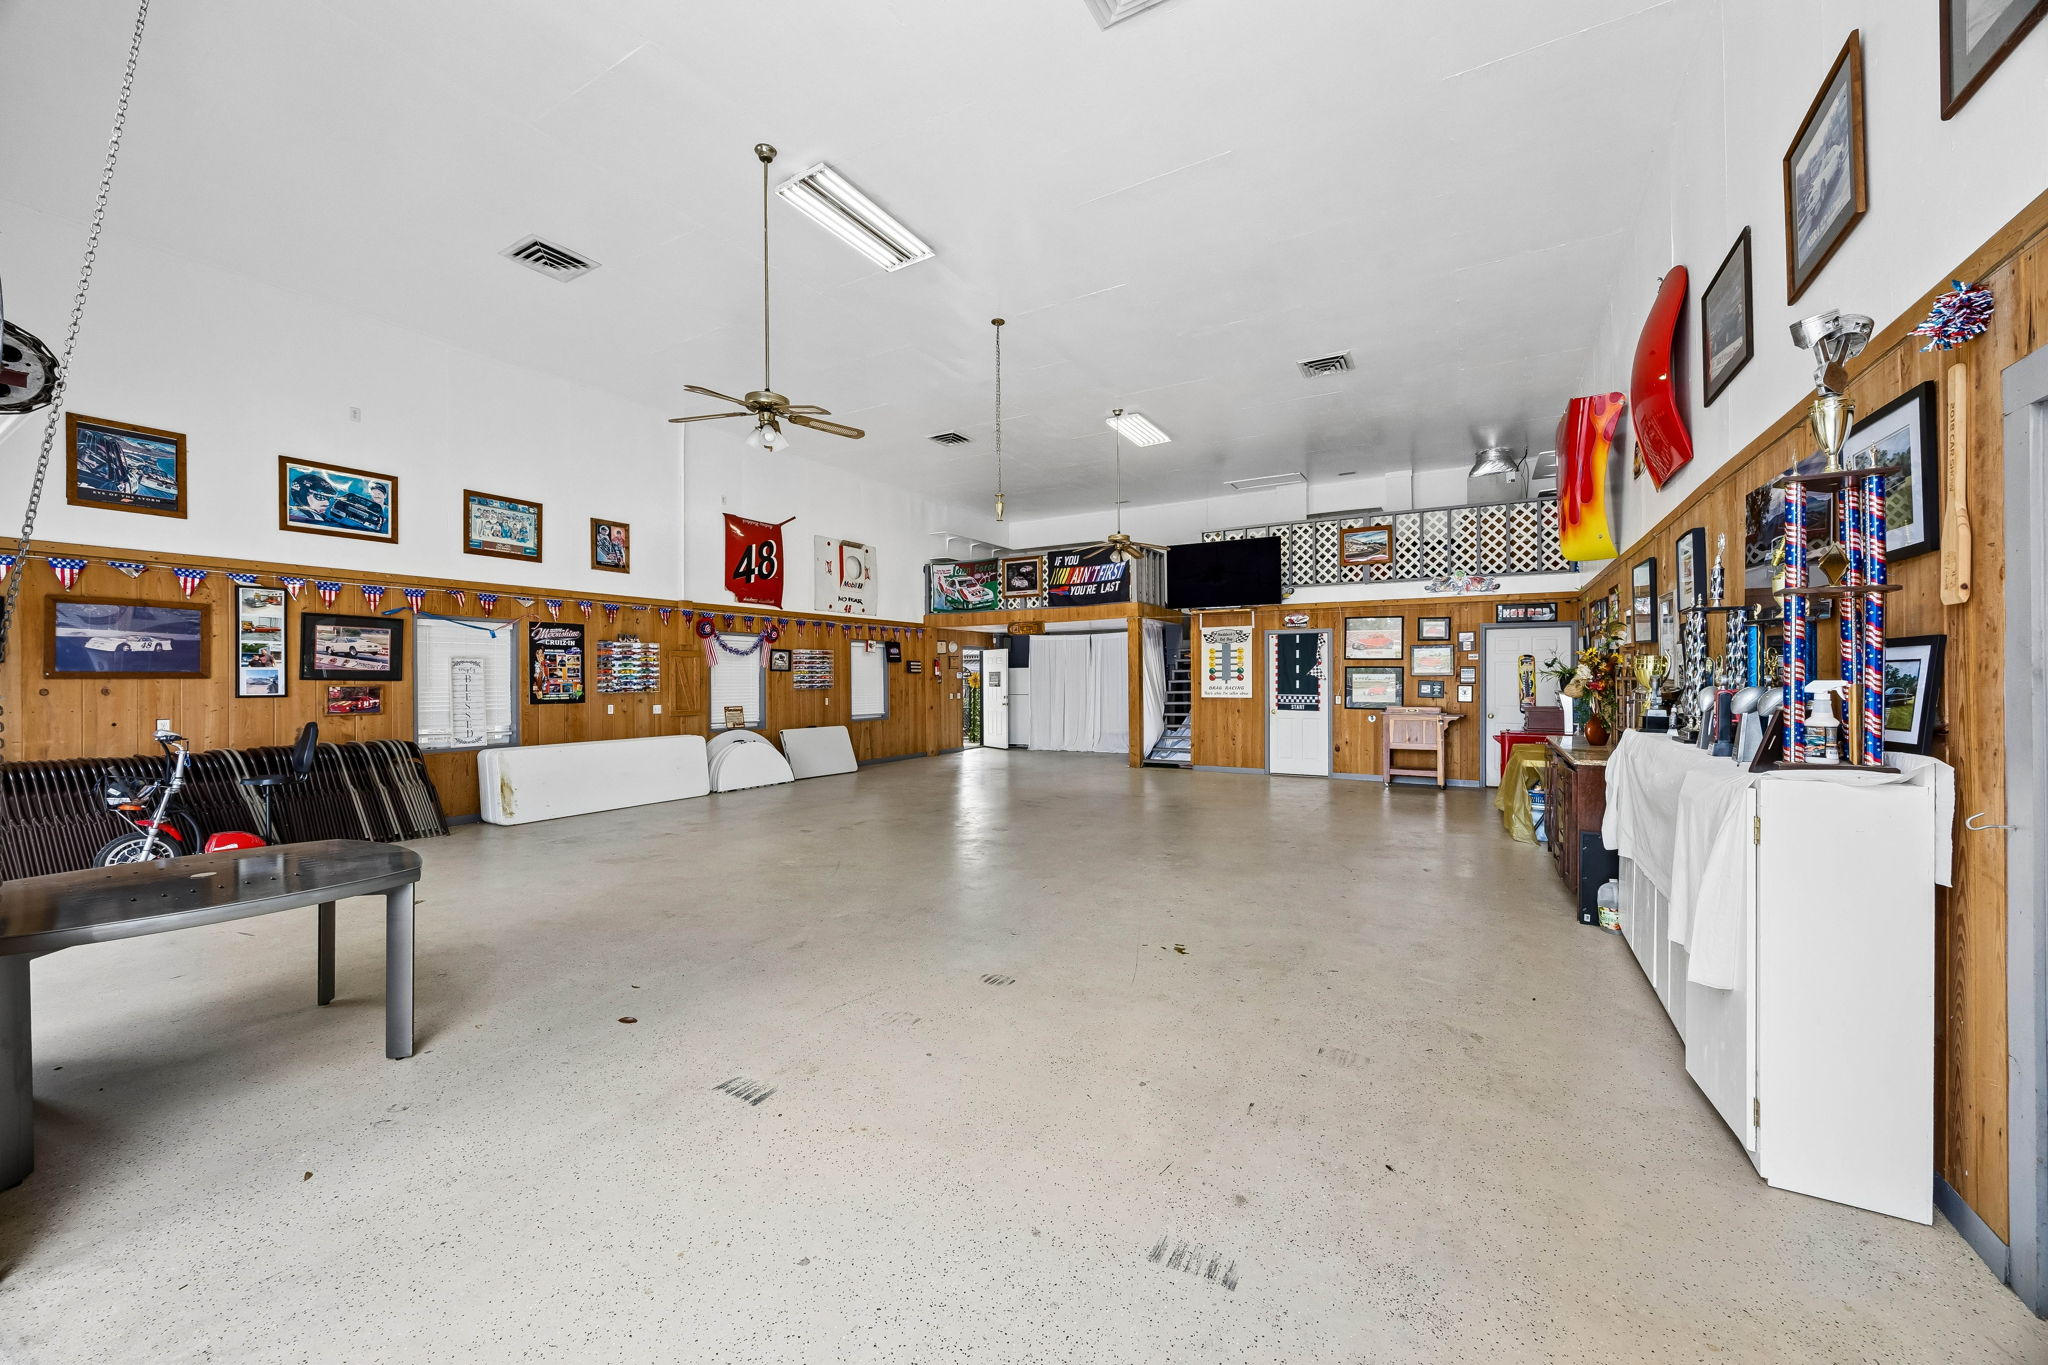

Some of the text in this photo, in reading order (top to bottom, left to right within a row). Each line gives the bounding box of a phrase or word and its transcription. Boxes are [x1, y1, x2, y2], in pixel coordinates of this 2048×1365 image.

[138, 496, 161, 504] STORM
[733, 540, 778, 585] 48
[1054, 555, 1080, 566] IF YOU
[1070, 561, 1126, 585] AIN'T FIRST
[844, 581, 857, 589] Mobil
[1070, 581, 1121, 596] YOU'RE LAST
[848, 597, 864, 605] FEAR
[1503, 608, 1525, 618] HOT
[465, 675, 474, 738] BLESSED
